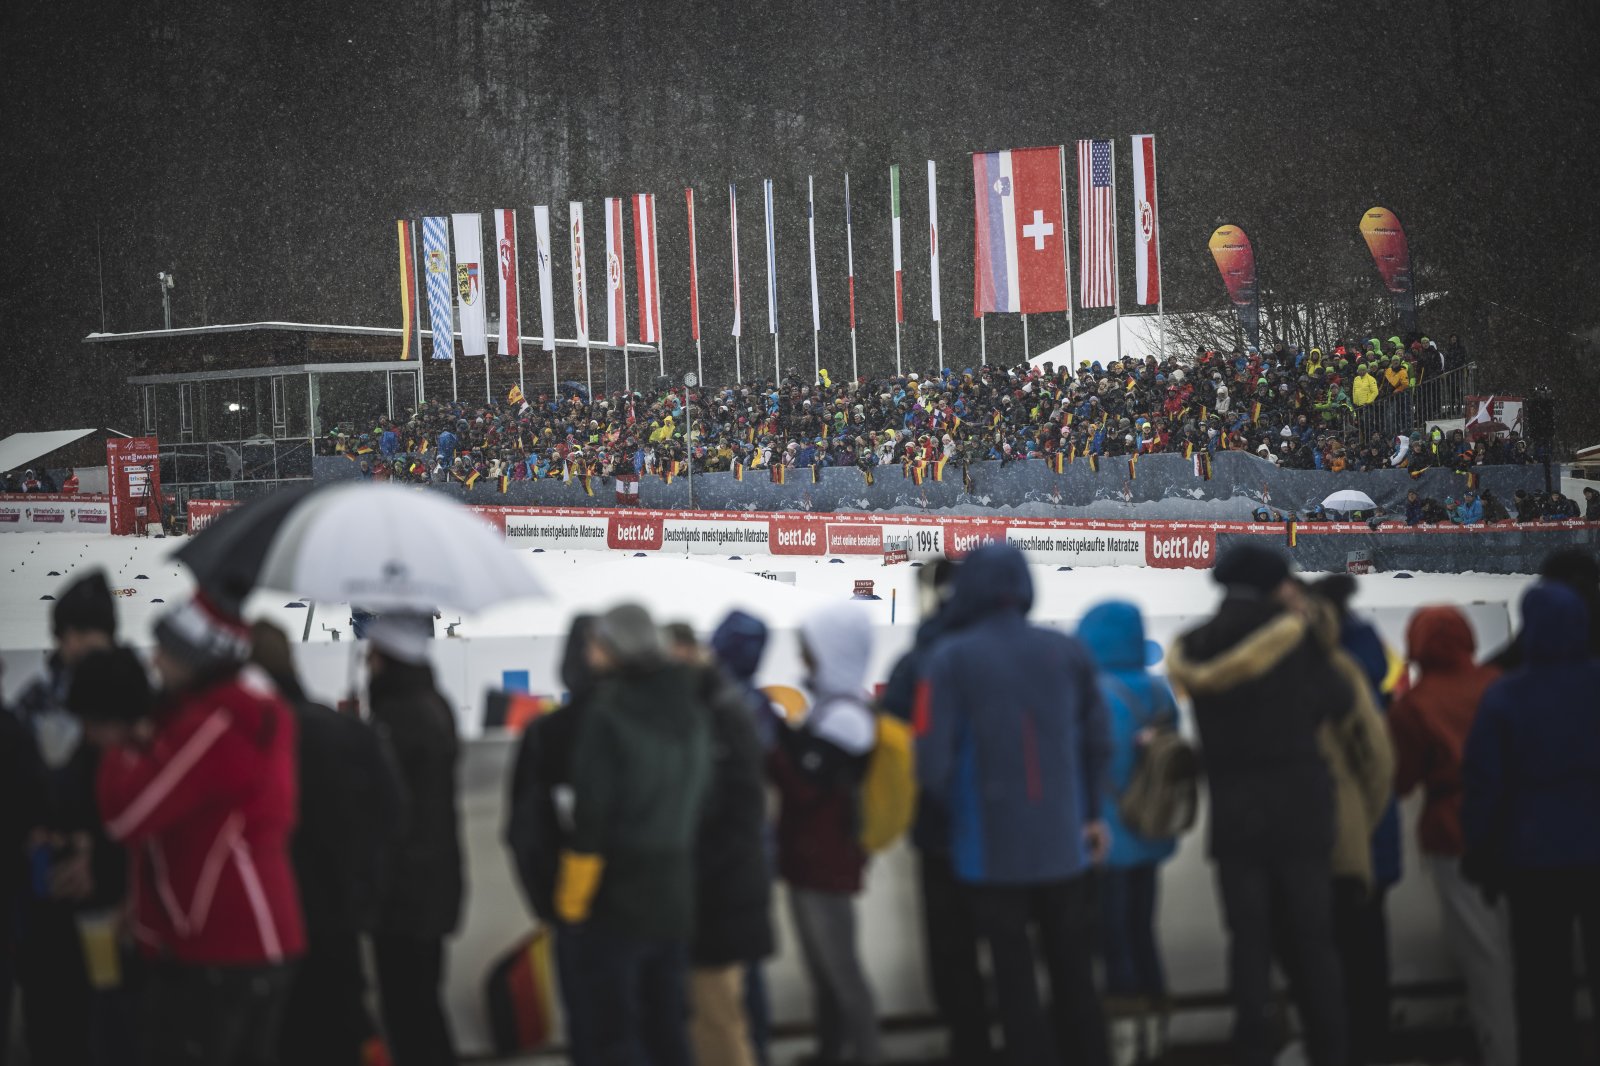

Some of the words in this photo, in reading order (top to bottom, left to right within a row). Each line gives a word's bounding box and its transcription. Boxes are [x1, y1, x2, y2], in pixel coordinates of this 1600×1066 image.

[507, 524, 540, 537] Deutschlands
[540, 524, 579, 540] meistgekaufte
[579, 524, 605, 538] Matratze
[617, 524, 654, 541] bett1.de
[664, 527, 701, 542] Deutschlands
[701, 527, 743, 546] meistgekaufte
[743, 528, 768, 543] Matratze
[778, 528, 817, 546] bett1.de
[831, 535, 843, 546] Jetzt
[917, 531, 932, 552] 199
[933, 531, 940, 553] €
[1008, 536, 1054, 552] Deutschlands
[1055, 537, 1105, 555] meistgekaufte
[1107, 537, 1139, 552] Matratze
[1153, 535, 1210, 559] bett1.de
